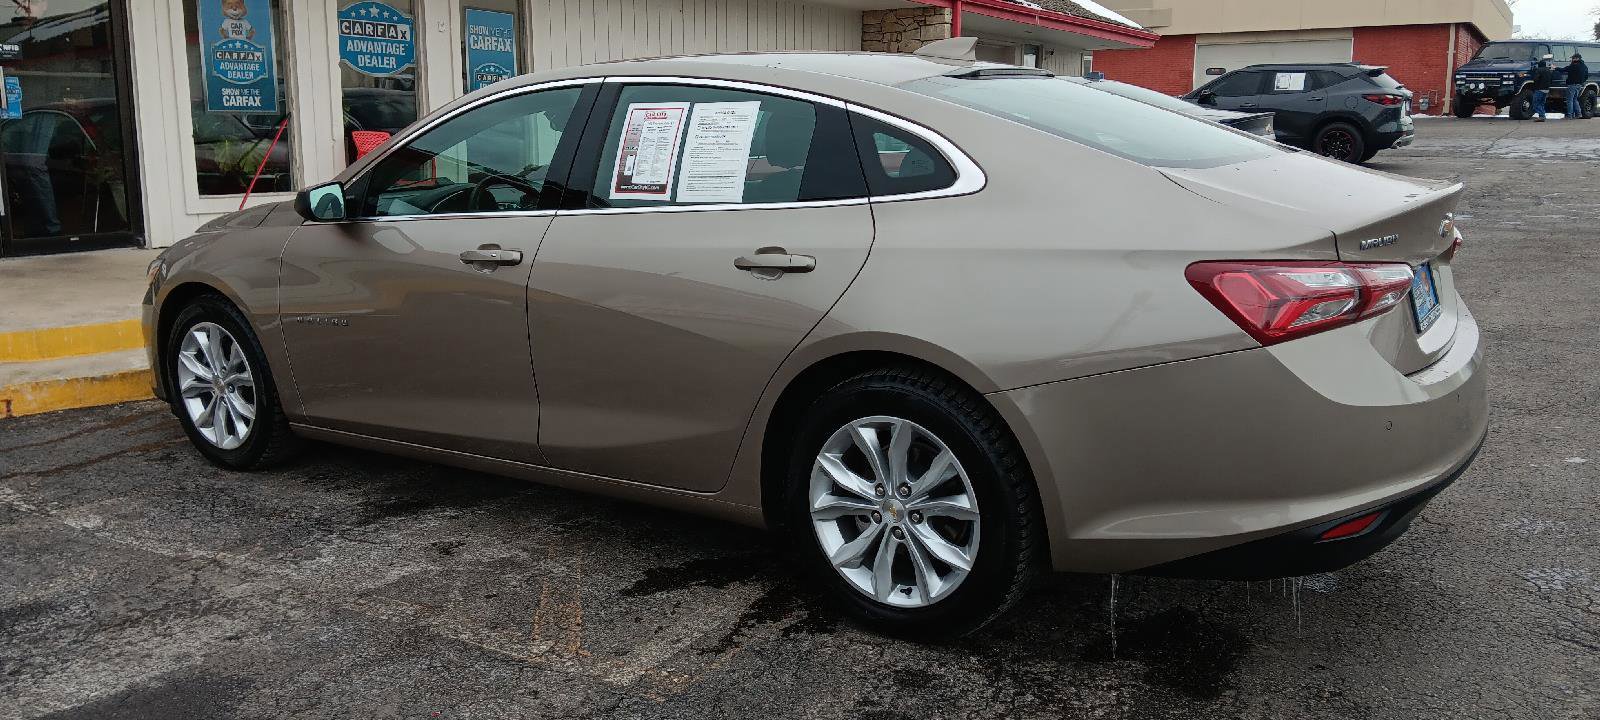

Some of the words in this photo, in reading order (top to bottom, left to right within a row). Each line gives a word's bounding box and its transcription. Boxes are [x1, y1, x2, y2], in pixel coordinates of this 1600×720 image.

[341, 21, 408, 40] CARFAX
[469, 24, 489, 35] SHOW
[346, 40, 406, 55] ADVANTAGE
[469, 34, 513, 52] CARFAX
[216, 52, 262, 61] CARFAX
[357, 54, 397, 68] DEALER
[220, 62, 260, 71] ADVANTAGE
[227, 70, 254, 79] DEALER
[221, 87, 240, 96] SHOW
[222, 95, 262, 107] CARFAX
[1359, 233, 1399, 250] MALIBU
